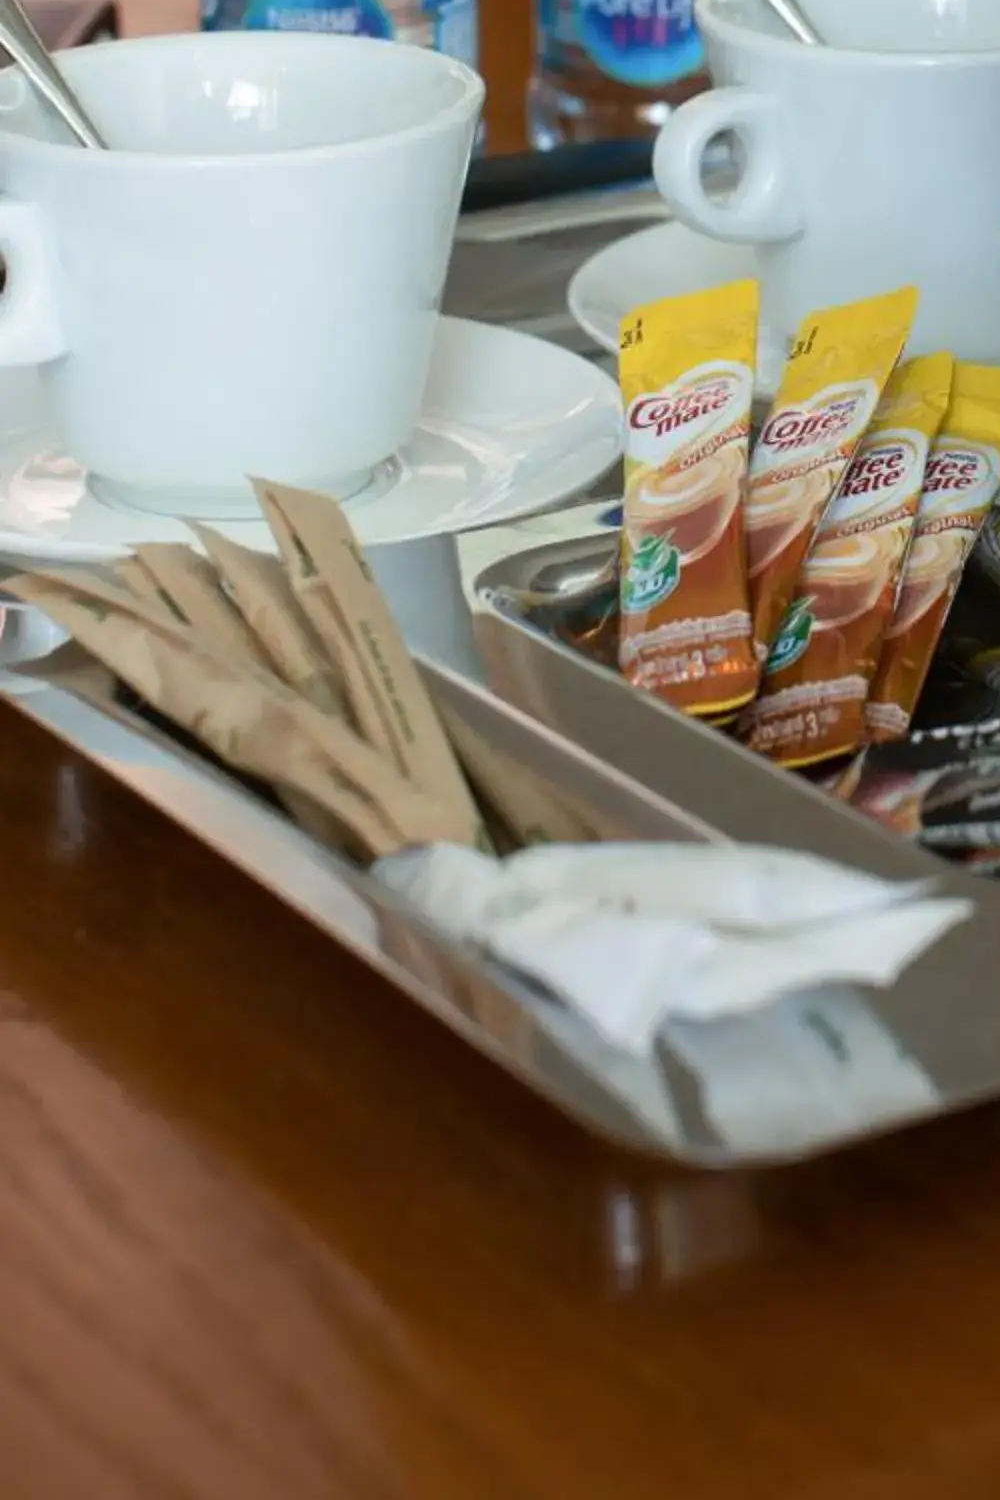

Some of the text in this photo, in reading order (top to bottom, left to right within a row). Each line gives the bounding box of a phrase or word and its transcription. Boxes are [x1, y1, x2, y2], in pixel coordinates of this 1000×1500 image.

[629, 387, 731, 430] Coffee
[655, 394, 730, 437] mate
[761, 410, 850, 446] Coffee
[921, 476, 973, 493] ate
